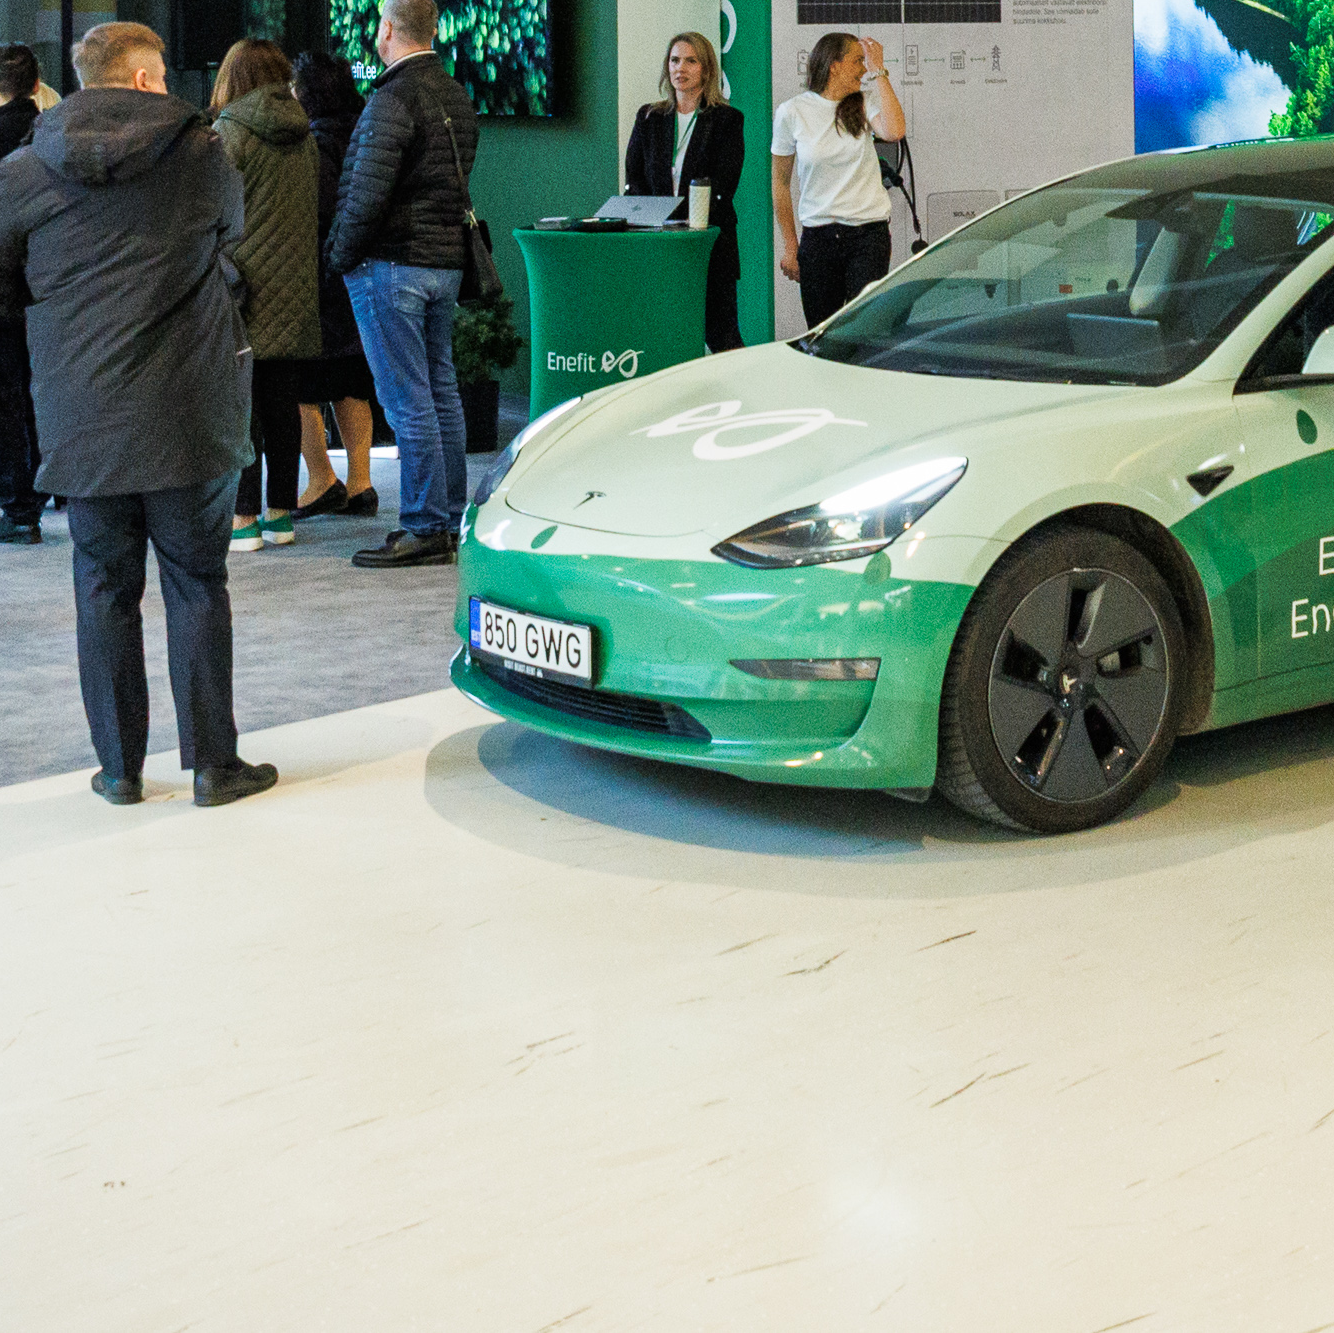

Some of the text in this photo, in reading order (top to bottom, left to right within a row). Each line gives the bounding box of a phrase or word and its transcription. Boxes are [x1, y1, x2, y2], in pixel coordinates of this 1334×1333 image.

[547, 352, 596, 373] Enefit
[485, 611, 517, 653] 850
[525, 623, 582, 669] GWG
